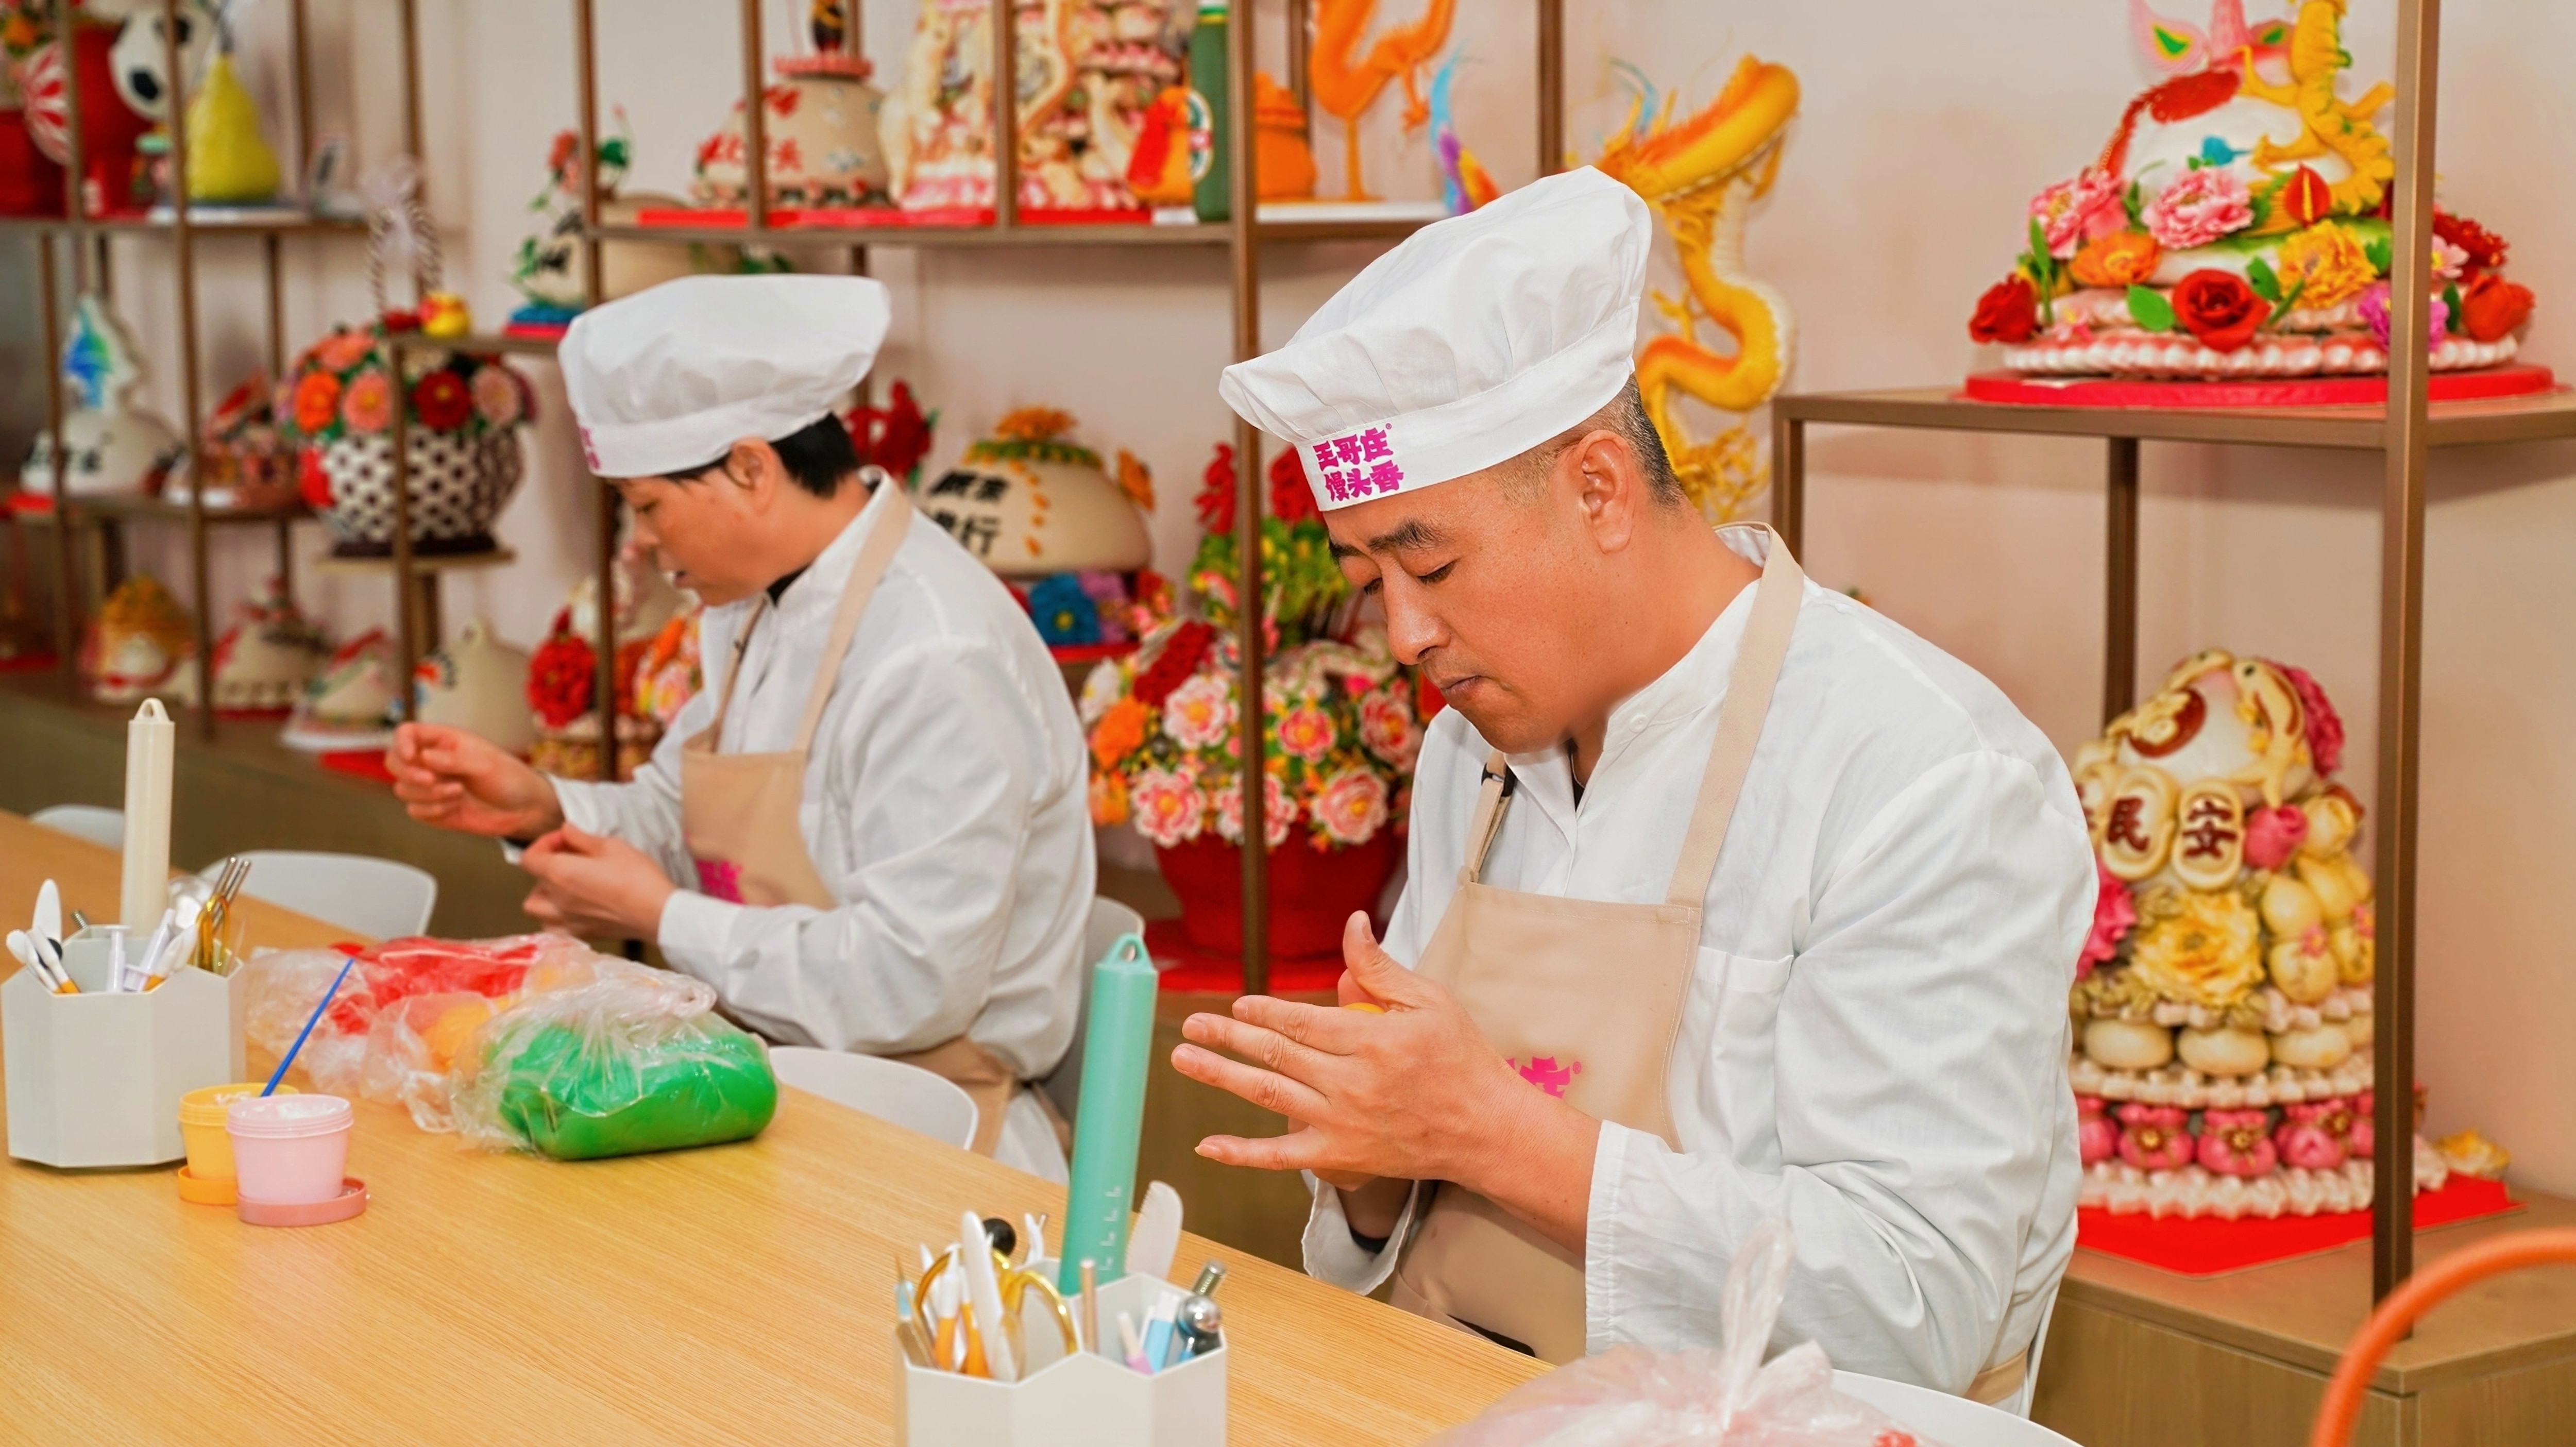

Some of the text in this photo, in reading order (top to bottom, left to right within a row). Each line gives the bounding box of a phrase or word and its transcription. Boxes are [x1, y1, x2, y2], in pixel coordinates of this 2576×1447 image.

[1313, 428, 1393, 471] 王哥庄
[1325, 460, 1403, 501] 馒头香
